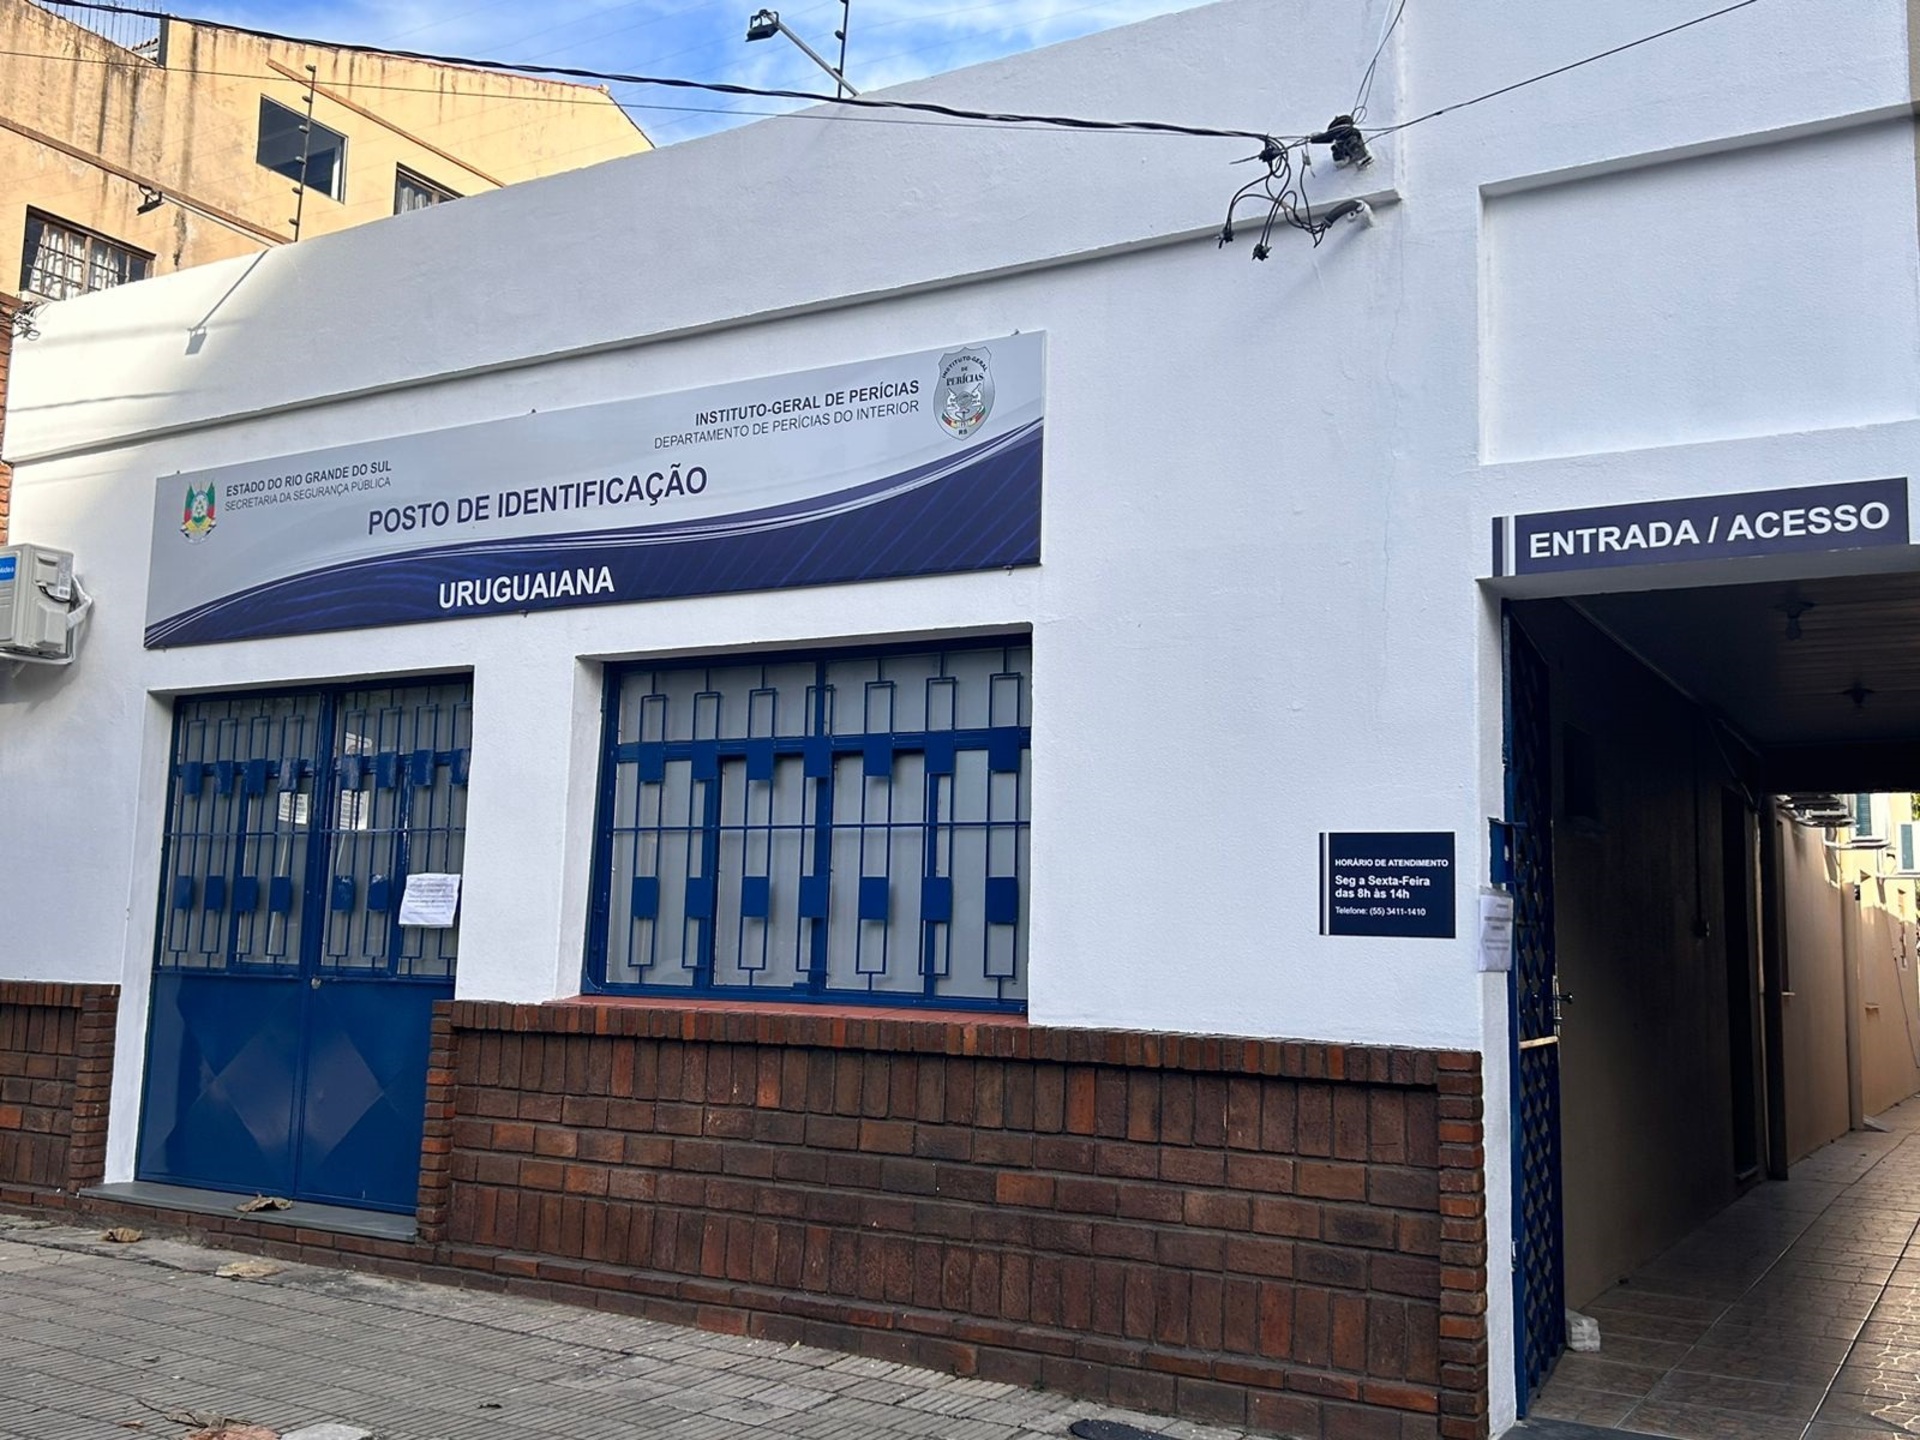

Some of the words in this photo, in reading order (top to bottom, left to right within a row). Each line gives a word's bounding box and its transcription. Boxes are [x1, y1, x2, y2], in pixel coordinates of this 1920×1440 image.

[946, 373, 984, 386] PERÍCIAS
[695, 396, 821, 426] INSTITUTO-GERAL
[825, 391, 845, 407] DE
[849, 380, 919, 403] PERÍCIAS
[654, 424, 750, 449] DEPARTAMENTO
[752, 422, 769, 435] DE
[773, 413, 830, 432] PERÍCIAS
[834, 410, 853, 424] DO
[857, 400, 919, 420] INTERIOR
[224, 494, 277, 511] SECRETARIA
[279, 492, 291, 503] DA
[293, 483, 349, 501] SEGURANÇA
[351, 476, 391, 492] PÚBLICA
[226, 480, 265, 497] ESTADO
[267, 478, 282, 490] DO
[285, 474, 303, 487] RIO
[305, 467, 349, 484] GRANDE
[352, 464, 368, 477] DO
[370, 461, 392, 474] SUL
[368, 500, 449, 535] POSTO
[457, 495, 490, 523] DE
[497, 463, 708, 518] IDENTIFICAÇÃO
[1529, 519, 1700, 559] ENTRADA
[1708, 516, 1719, 544] /
[1726, 501, 1890, 541] ACESSO
[439, 565, 615, 609] URUGUAIANA
[1335, 858, 1373, 867] HORÁRIO
[1374, 859, 1387, 867] DE
[1387, 859, 1449, 867] ATENDIMENTO
[1335, 875, 1356, 887] Seg
[1368, 875, 1431, 886] Sexta-Feira
[1335, 888, 1355, 898] das
[1357, 888, 1371, 898] 8h
[1373, 888, 1387, 898] às
[1390, 889, 1410, 899] 14h
[1335, 906, 1368, 915] Telefone:
[1369, 907, 1385, 916] (55)
[1386, 907, 1427, 916] 3411-1410
